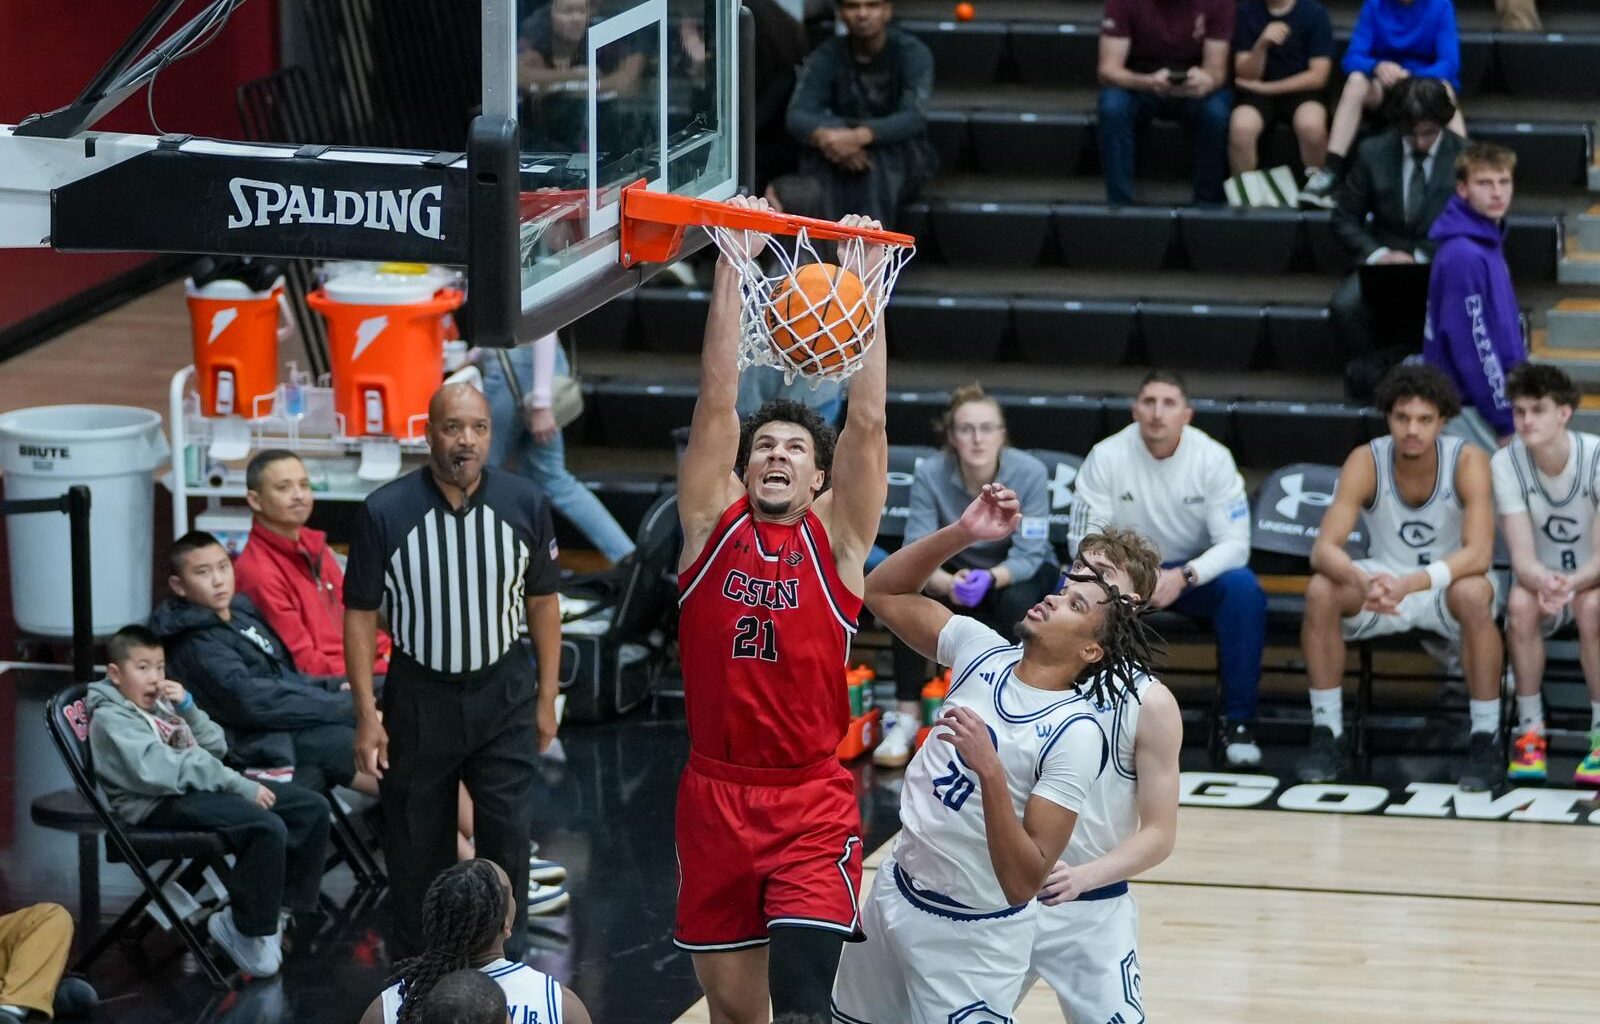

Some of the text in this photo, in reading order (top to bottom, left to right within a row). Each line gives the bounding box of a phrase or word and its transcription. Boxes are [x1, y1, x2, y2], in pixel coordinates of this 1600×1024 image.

[228, 177, 443, 240] SPALDING
[19, 444, 70, 459] BRUTE
[732, 615, 778, 662] 21
[933, 761, 975, 812] 20
[1179, 771, 1600, 826] GOM
